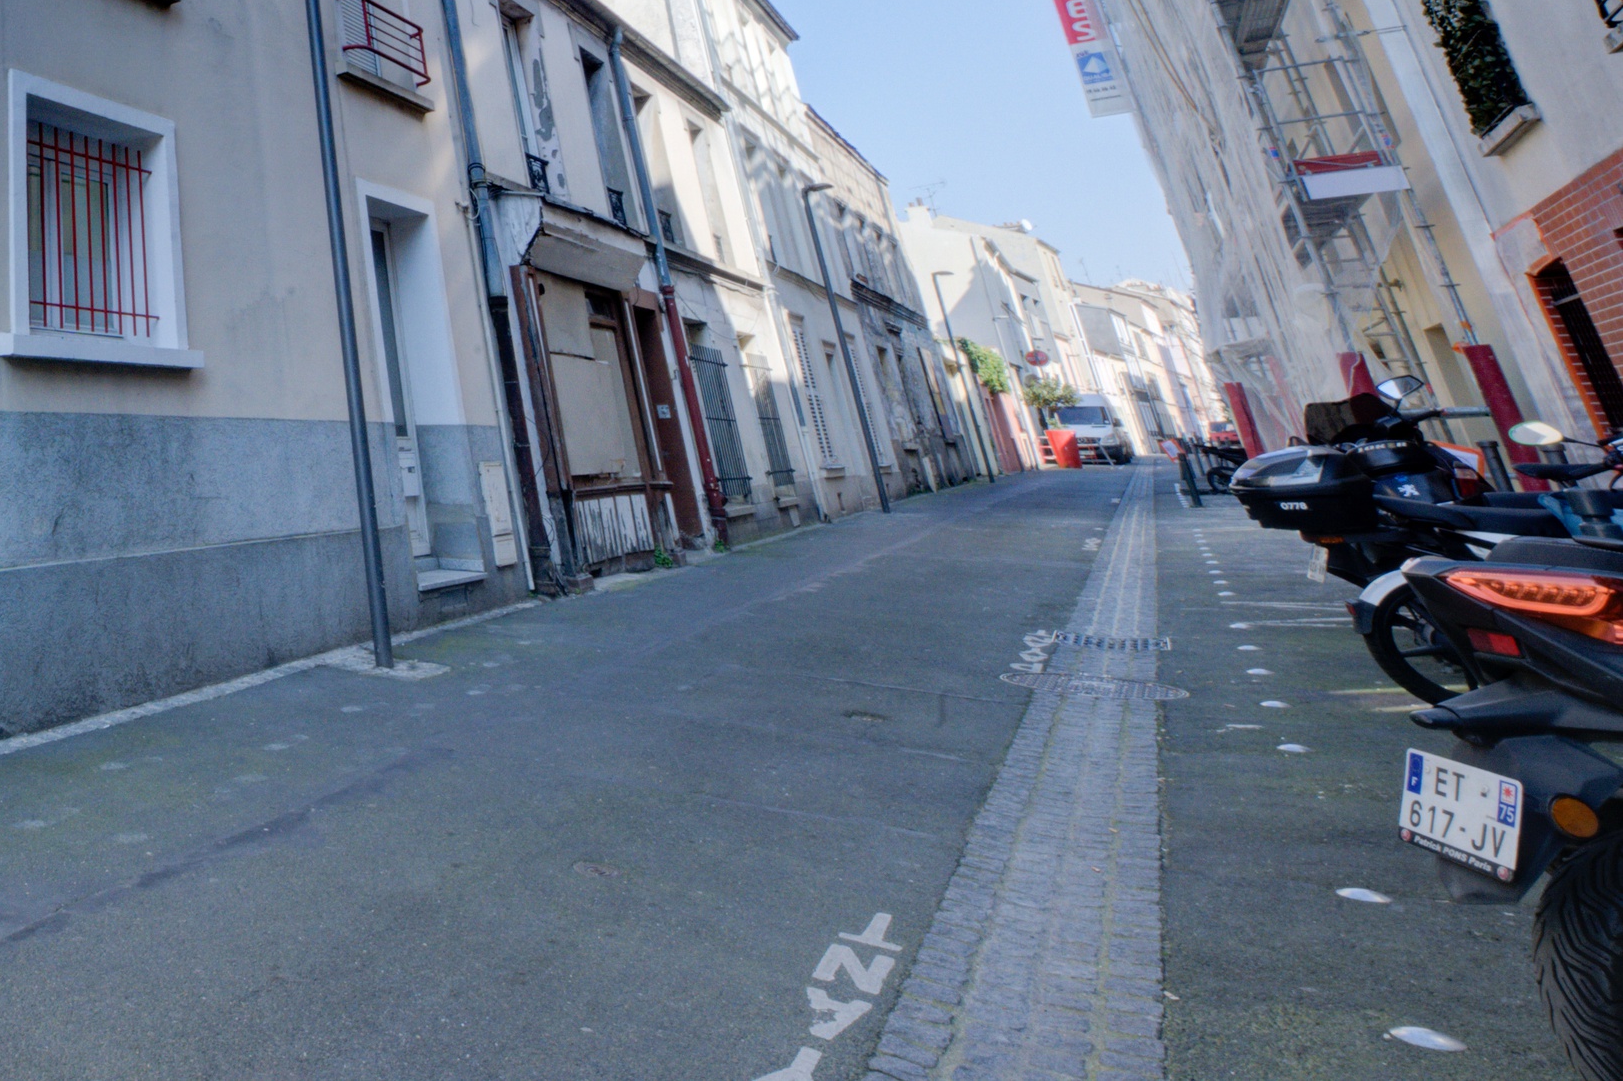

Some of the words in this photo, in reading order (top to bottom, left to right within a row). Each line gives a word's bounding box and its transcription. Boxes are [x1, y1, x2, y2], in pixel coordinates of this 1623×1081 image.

[1411, 776, 1418, 786] F
[1498, 803, 1515, 823] 75
[1414, 834, 1442, 853] Patrick
[1442, 843, 1468, 863] PONS
[1468, 855, 1492, 872] Paris
